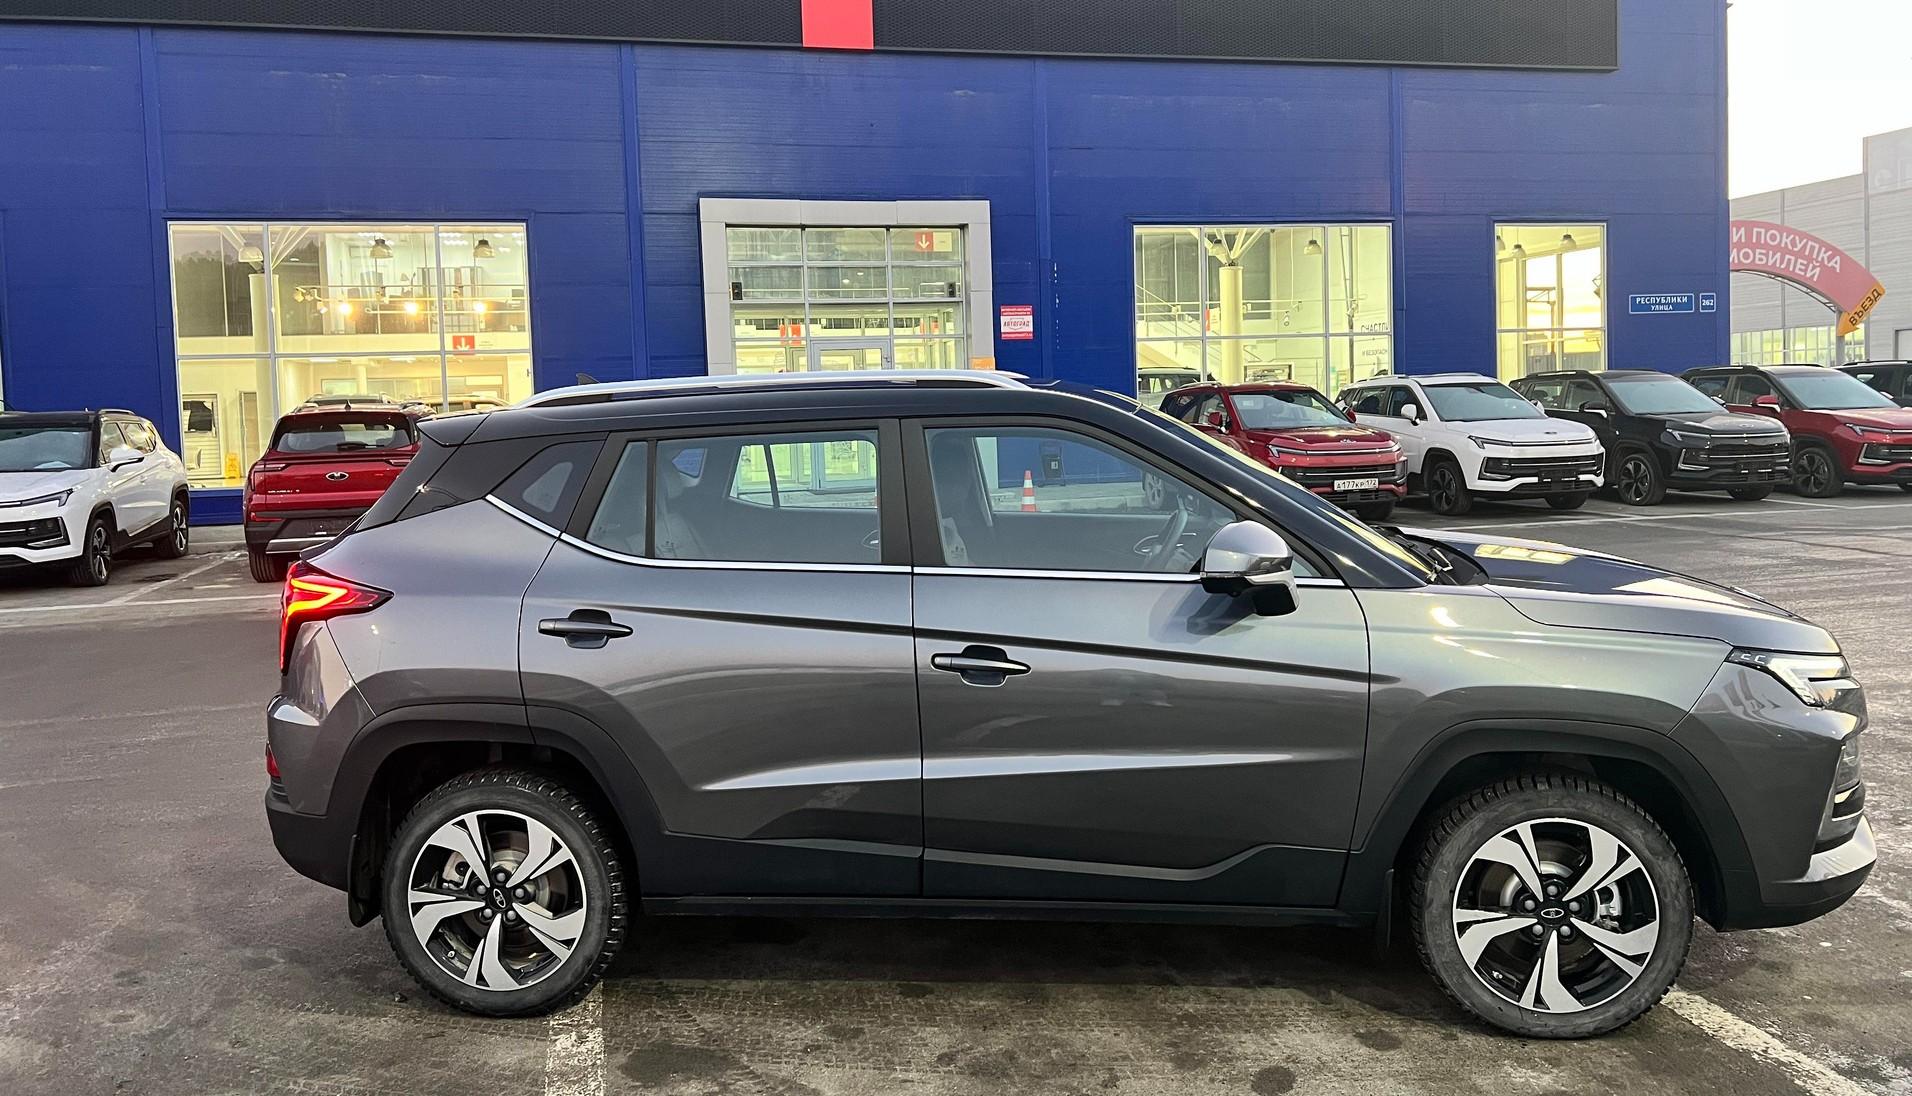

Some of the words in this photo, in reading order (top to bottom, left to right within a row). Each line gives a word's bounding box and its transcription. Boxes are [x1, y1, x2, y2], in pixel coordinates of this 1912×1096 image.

[1732, 226, 1746, 243] И
[1752, 227, 1841, 273] ПОКУПКА
[1636, 296, 1688, 304] РЕСПУБЛИКИ
[1848, 288, 1883, 327] ВЪЕЗД
